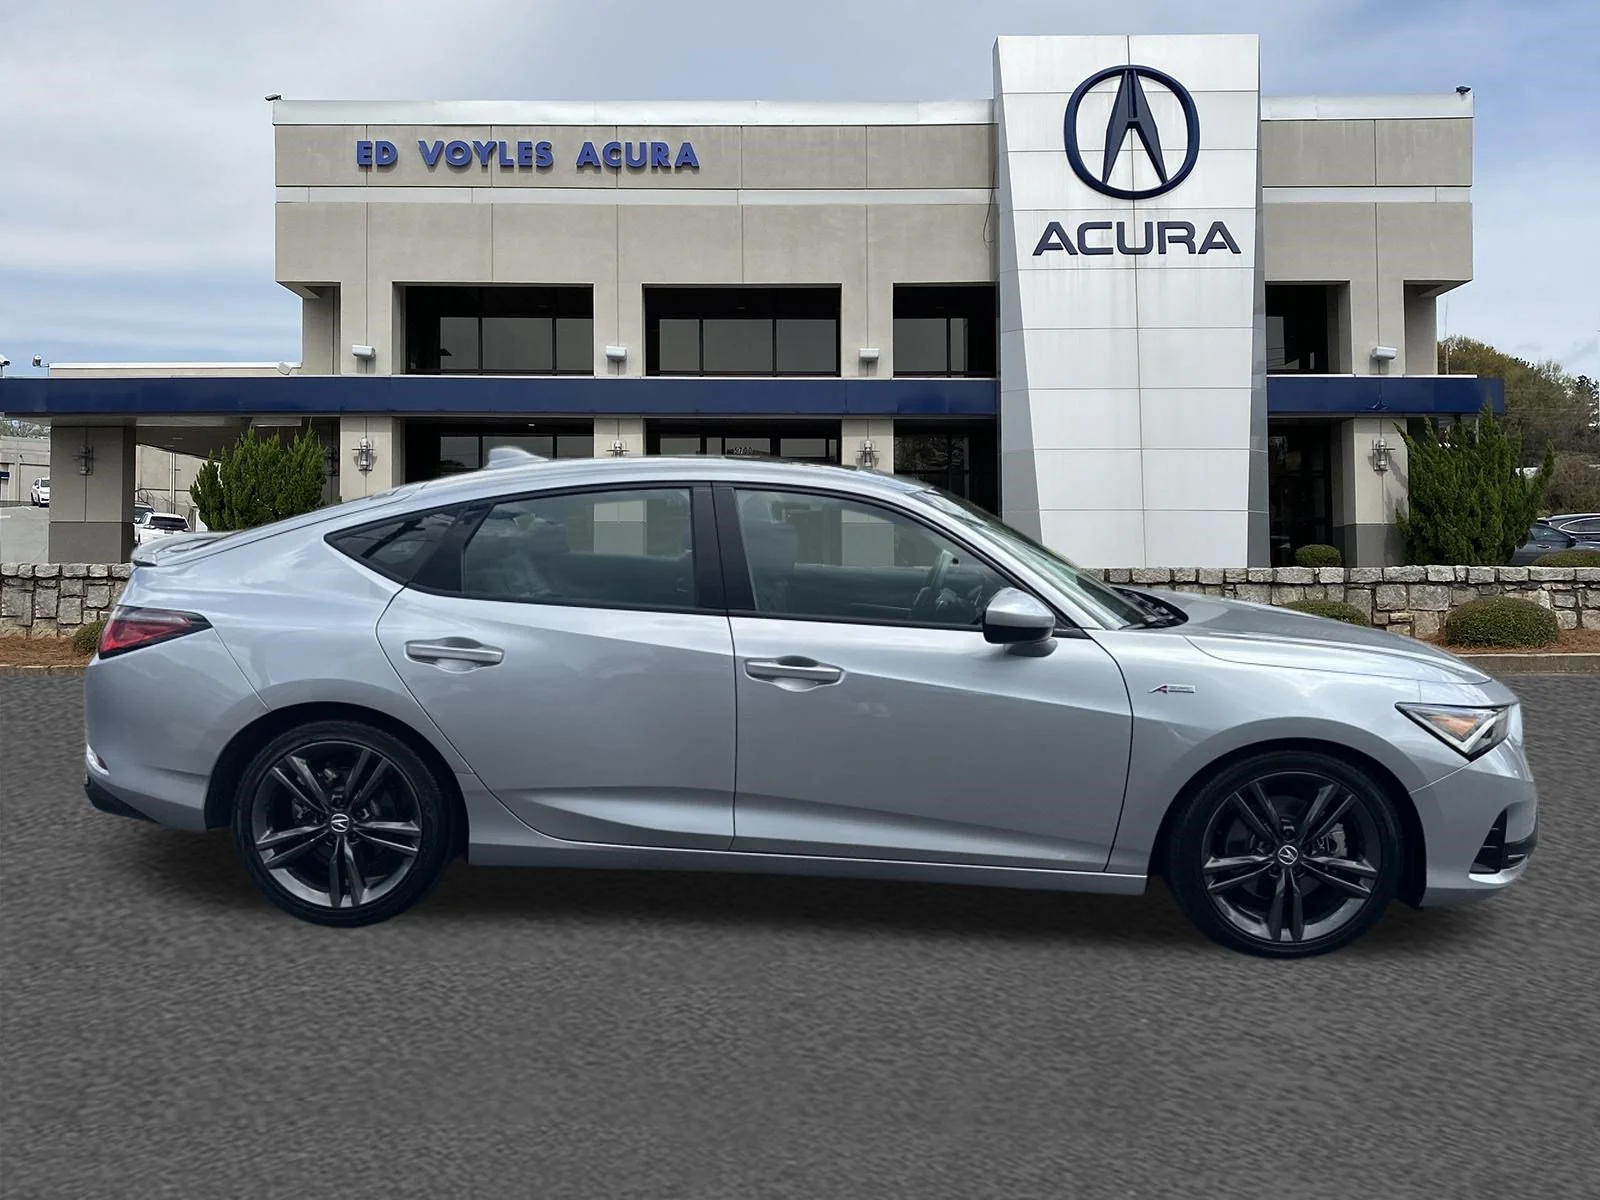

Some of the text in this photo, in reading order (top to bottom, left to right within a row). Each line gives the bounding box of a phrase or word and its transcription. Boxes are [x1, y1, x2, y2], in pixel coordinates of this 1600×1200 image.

[356, 141, 700, 168] ED VOYLES ACURA
[1032, 221, 1242, 255] ACURA
